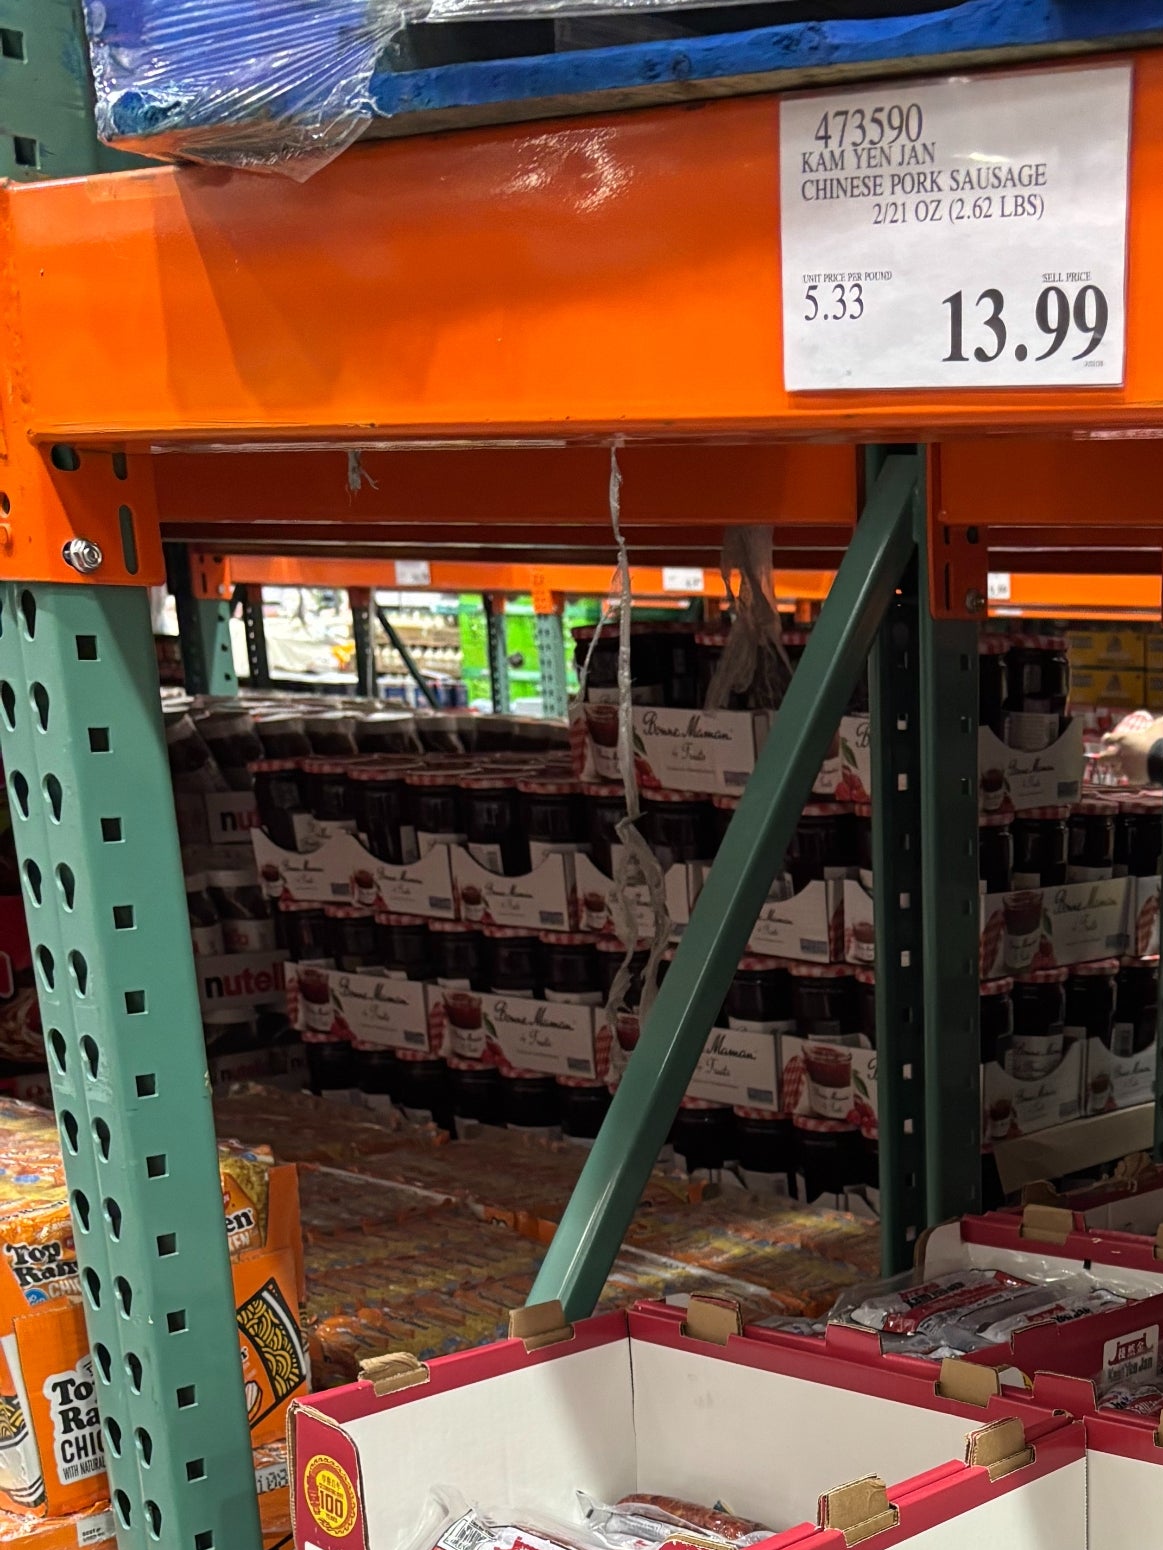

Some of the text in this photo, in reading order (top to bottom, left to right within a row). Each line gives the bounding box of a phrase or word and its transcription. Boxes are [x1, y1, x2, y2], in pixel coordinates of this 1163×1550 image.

[815, 103, 923, 148] 473590
[801, 142, 936, 173] KAM YEN JAN
[801, 163, 1048, 201] CHINESE PORK SAUSAGE
[872, 193, 1046, 226] 2/21 OZ (2.62 LBS)
[802, 271, 893, 283] UNIT PRICE PER POUND
[1041, 271, 1091, 283] SELL PRICE
[804, 283, 864, 321] 5.33
[941, 285, 1109, 362] 13.99
[205, 963, 285, 998] nutell
[706, 1033, 756, 1060] Maman
[5, 1242, 61, 1265] Top
